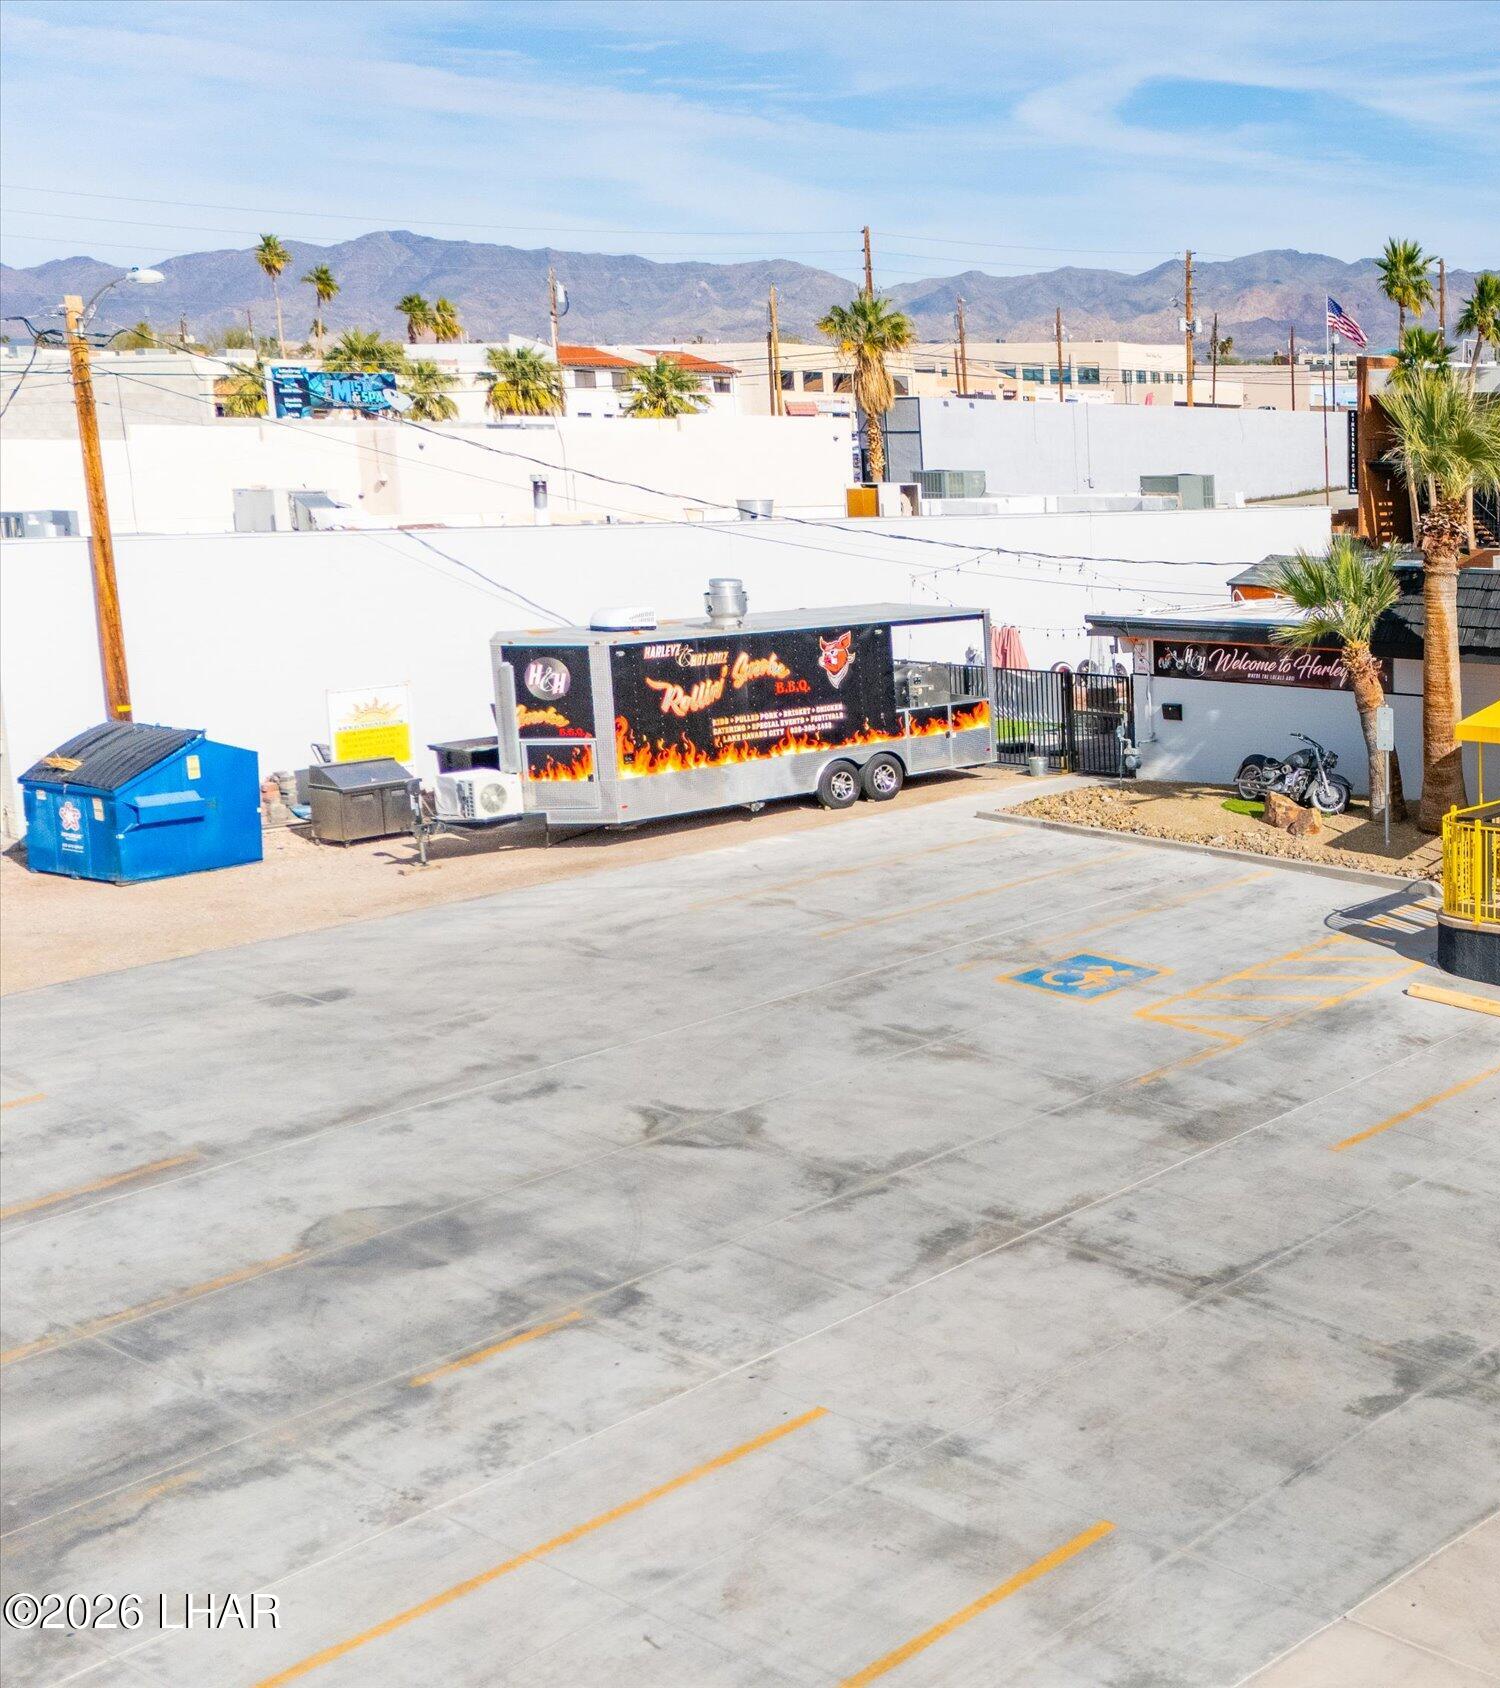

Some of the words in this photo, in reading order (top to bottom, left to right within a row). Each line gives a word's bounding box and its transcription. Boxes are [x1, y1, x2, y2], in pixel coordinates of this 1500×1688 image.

[361, 390, 385, 403] SPA
[644, 643, 682, 660] HARLEYZ
[690, 653, 707, 667] HOT
[1209, 648, 1276, 673] Welcome
[1278, 653, 1293, 674] to
[1293, 654, 1349, 688] Harley
